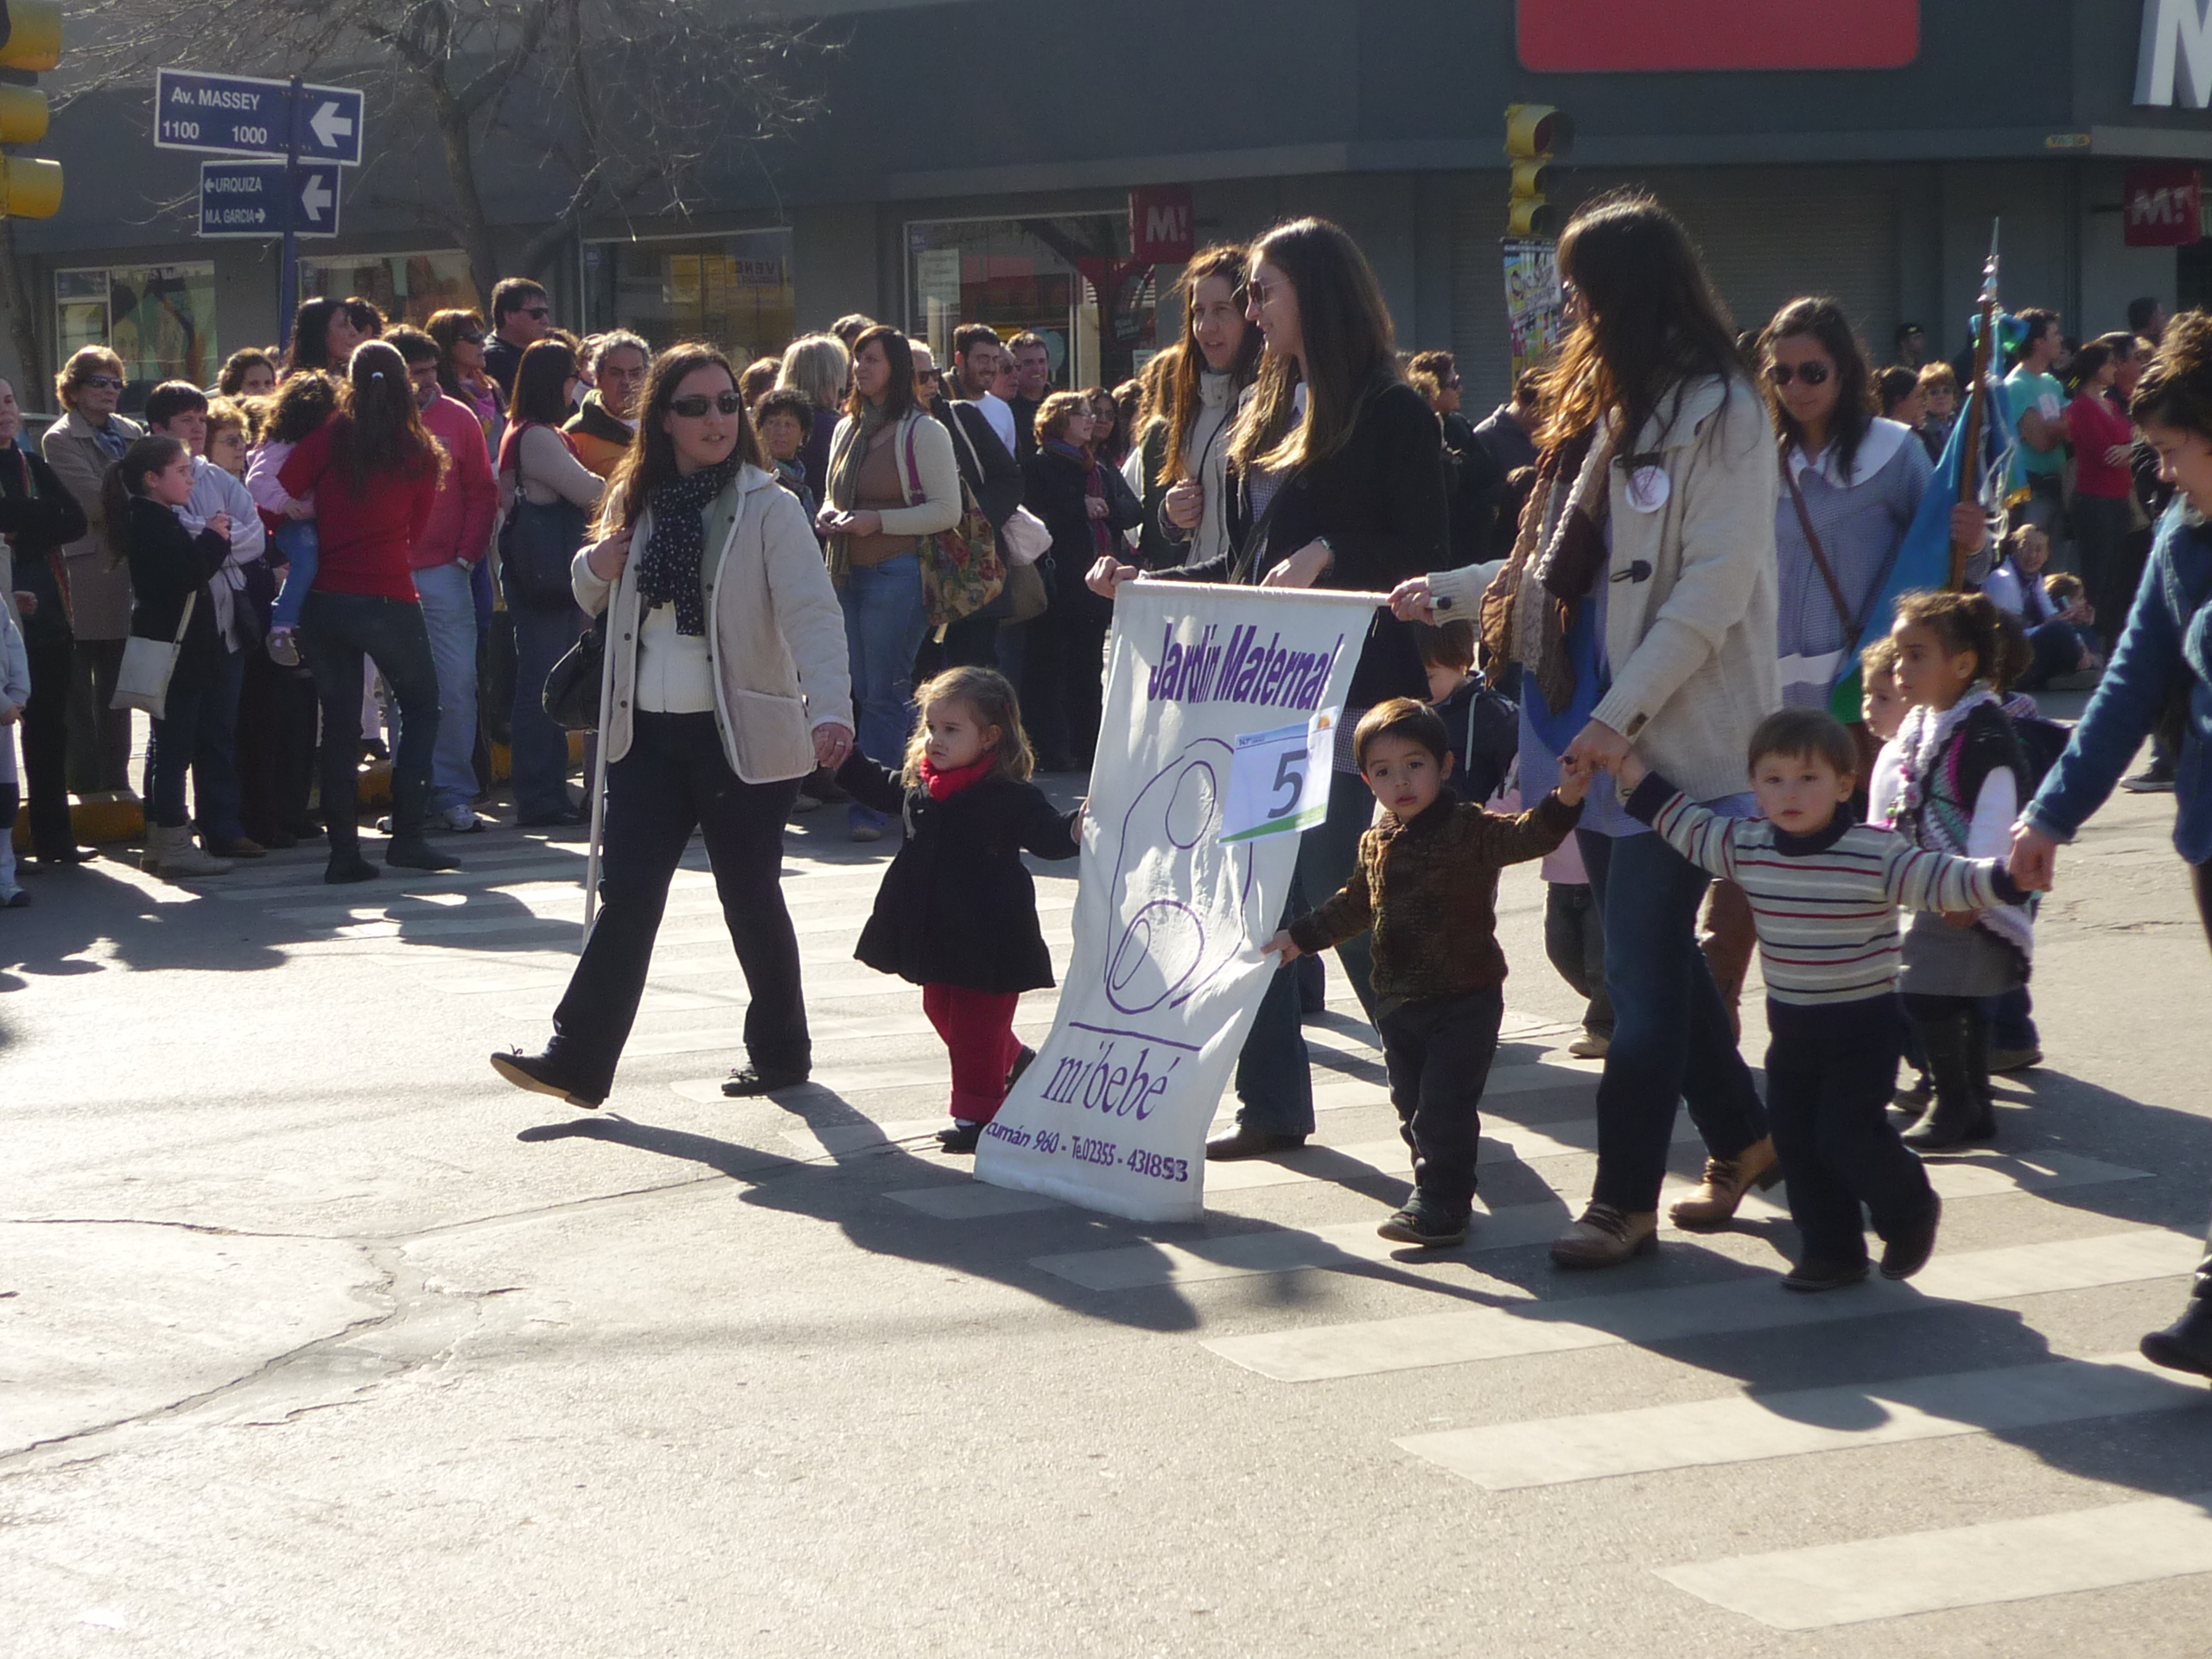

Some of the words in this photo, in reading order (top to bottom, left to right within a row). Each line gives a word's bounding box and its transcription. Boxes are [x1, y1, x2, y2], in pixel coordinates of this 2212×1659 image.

[171, 86, 194, 105] Av.
[198, 89, 260, 111] MASSEY
[162, 120, 200, 139] 1100
[232, 125, 268, 144] 1000
[215, 176, 263, 193] URQUIZA
[223, 208, 255, 224] GARCIA
[1145, 205, 1188, 243] M!
[1212, 624, 1344, 711] Maternal
[1267, 748, 1308, 819] 5
[1032, 1129, 1060, 1154] 960
